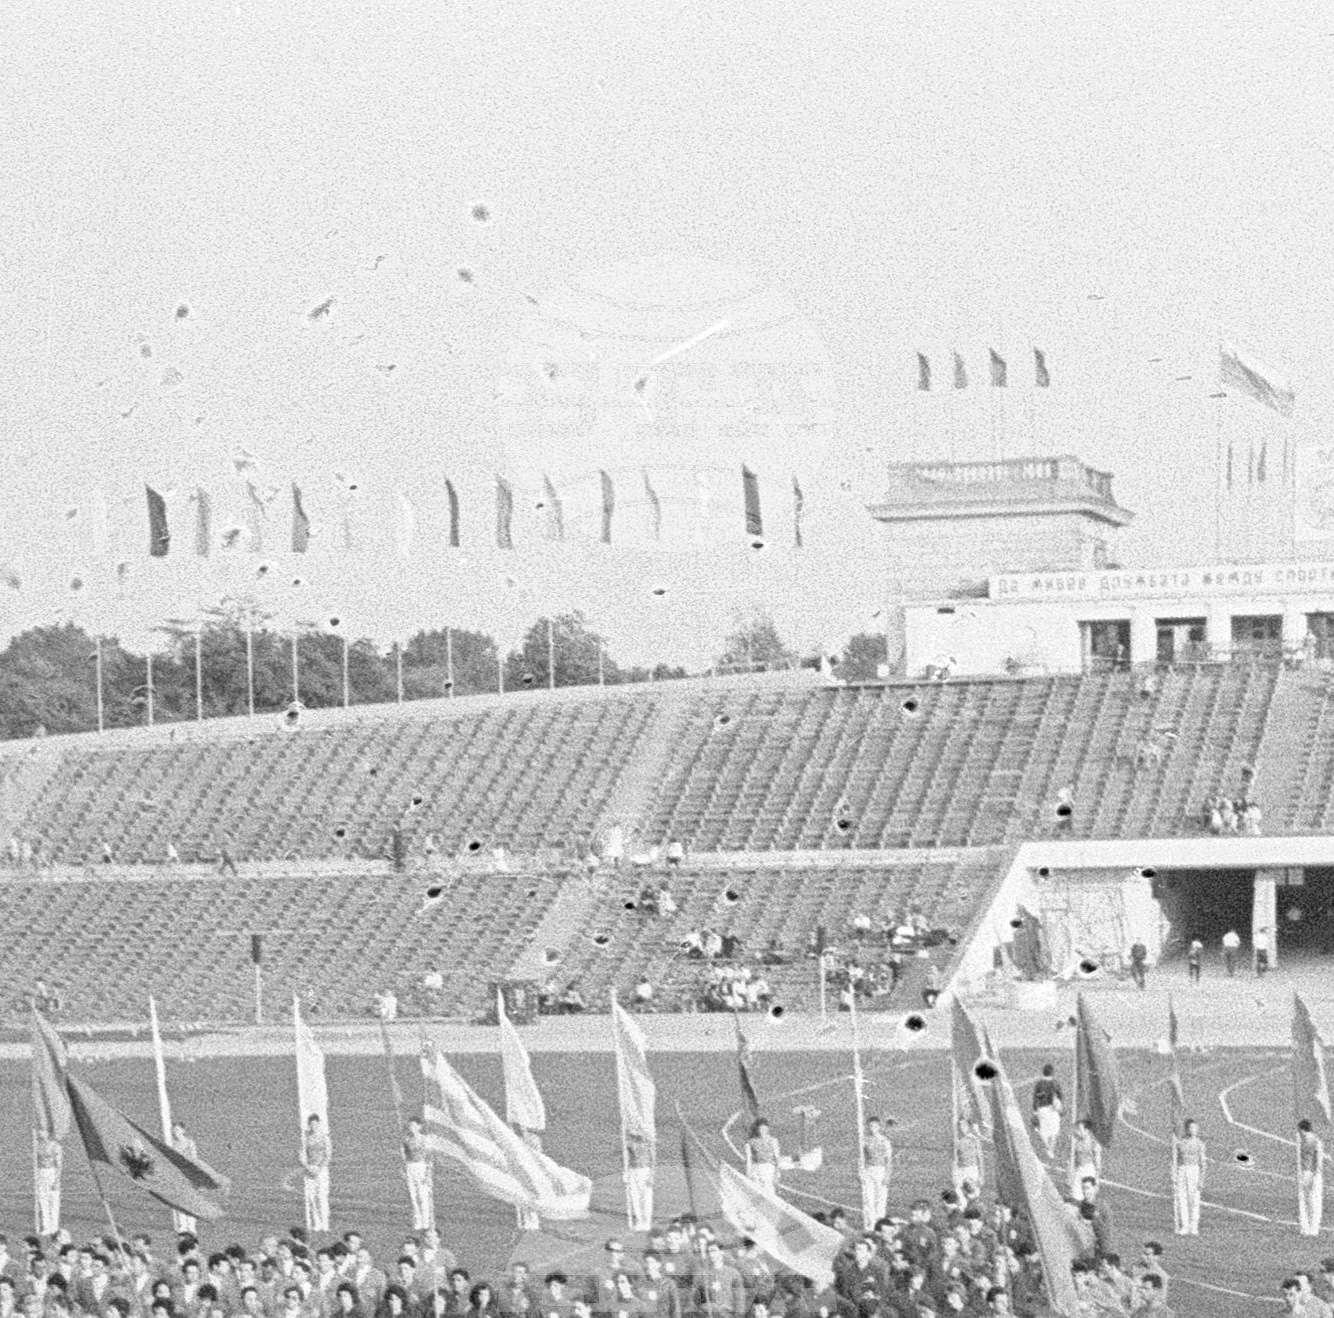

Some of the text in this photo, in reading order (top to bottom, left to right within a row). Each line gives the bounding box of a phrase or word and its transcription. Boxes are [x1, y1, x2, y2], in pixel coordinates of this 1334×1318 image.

[998, 577, 1019, 596] ДА
[1032, 575, 1087, 592] ЖИВЕЕ
[1100, 572, 1190, 592] ДРУЖБАТА
[1201, 569, 1263, 587] МЕЖДУ
